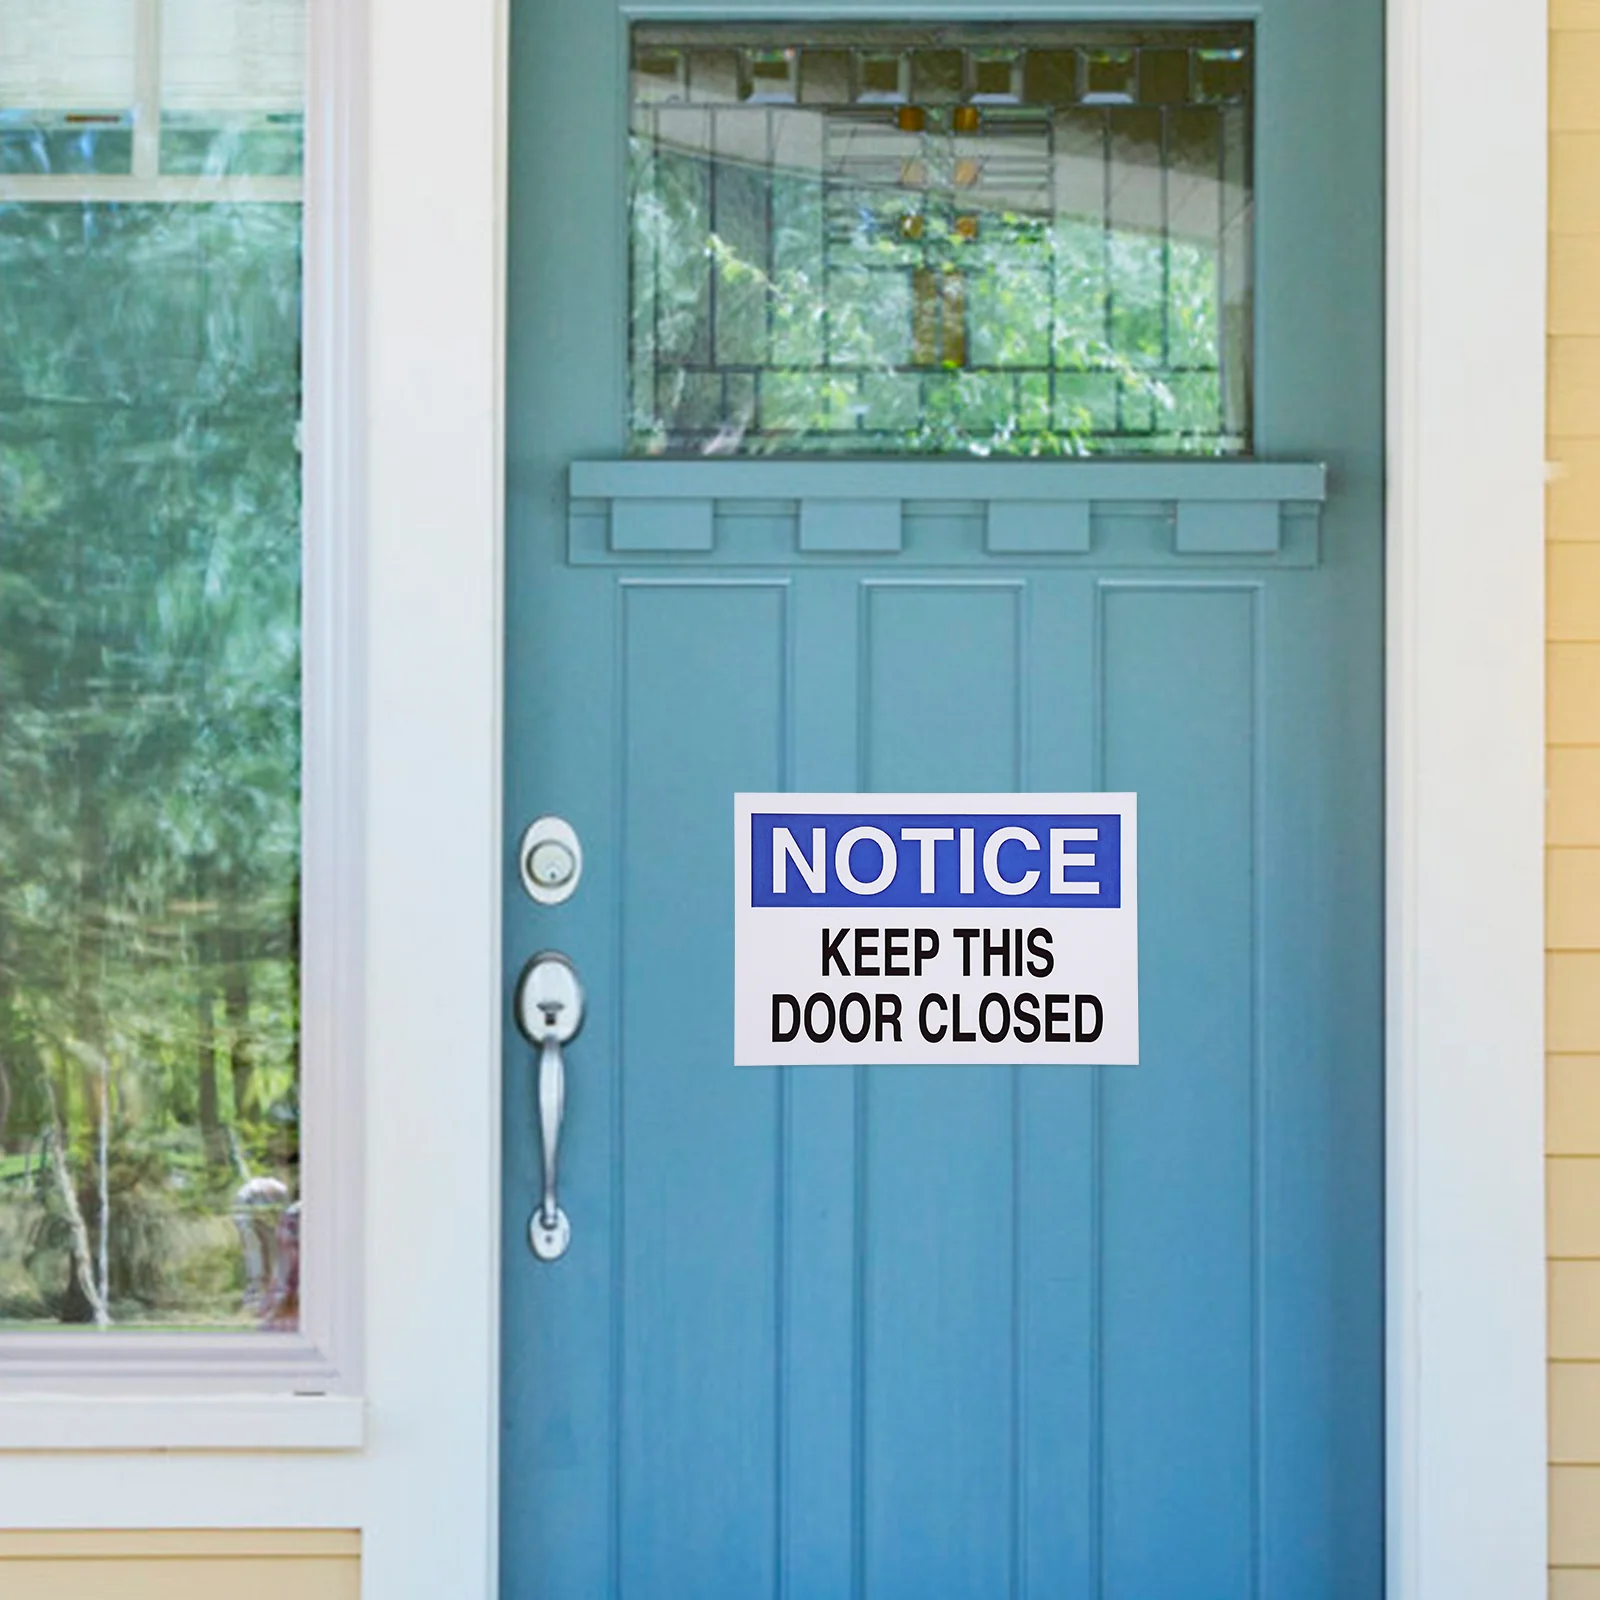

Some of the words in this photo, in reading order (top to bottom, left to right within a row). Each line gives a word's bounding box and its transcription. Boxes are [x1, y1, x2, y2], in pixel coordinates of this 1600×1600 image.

[772, 826, 1100, 896] NOTICE
[821, 928, 940, 977] KEEP
[953, 927, 1055, 978] THIS
[771, 992, 903, 1044] DOOR
[918, 992, 1104, 1044] CLOSED
